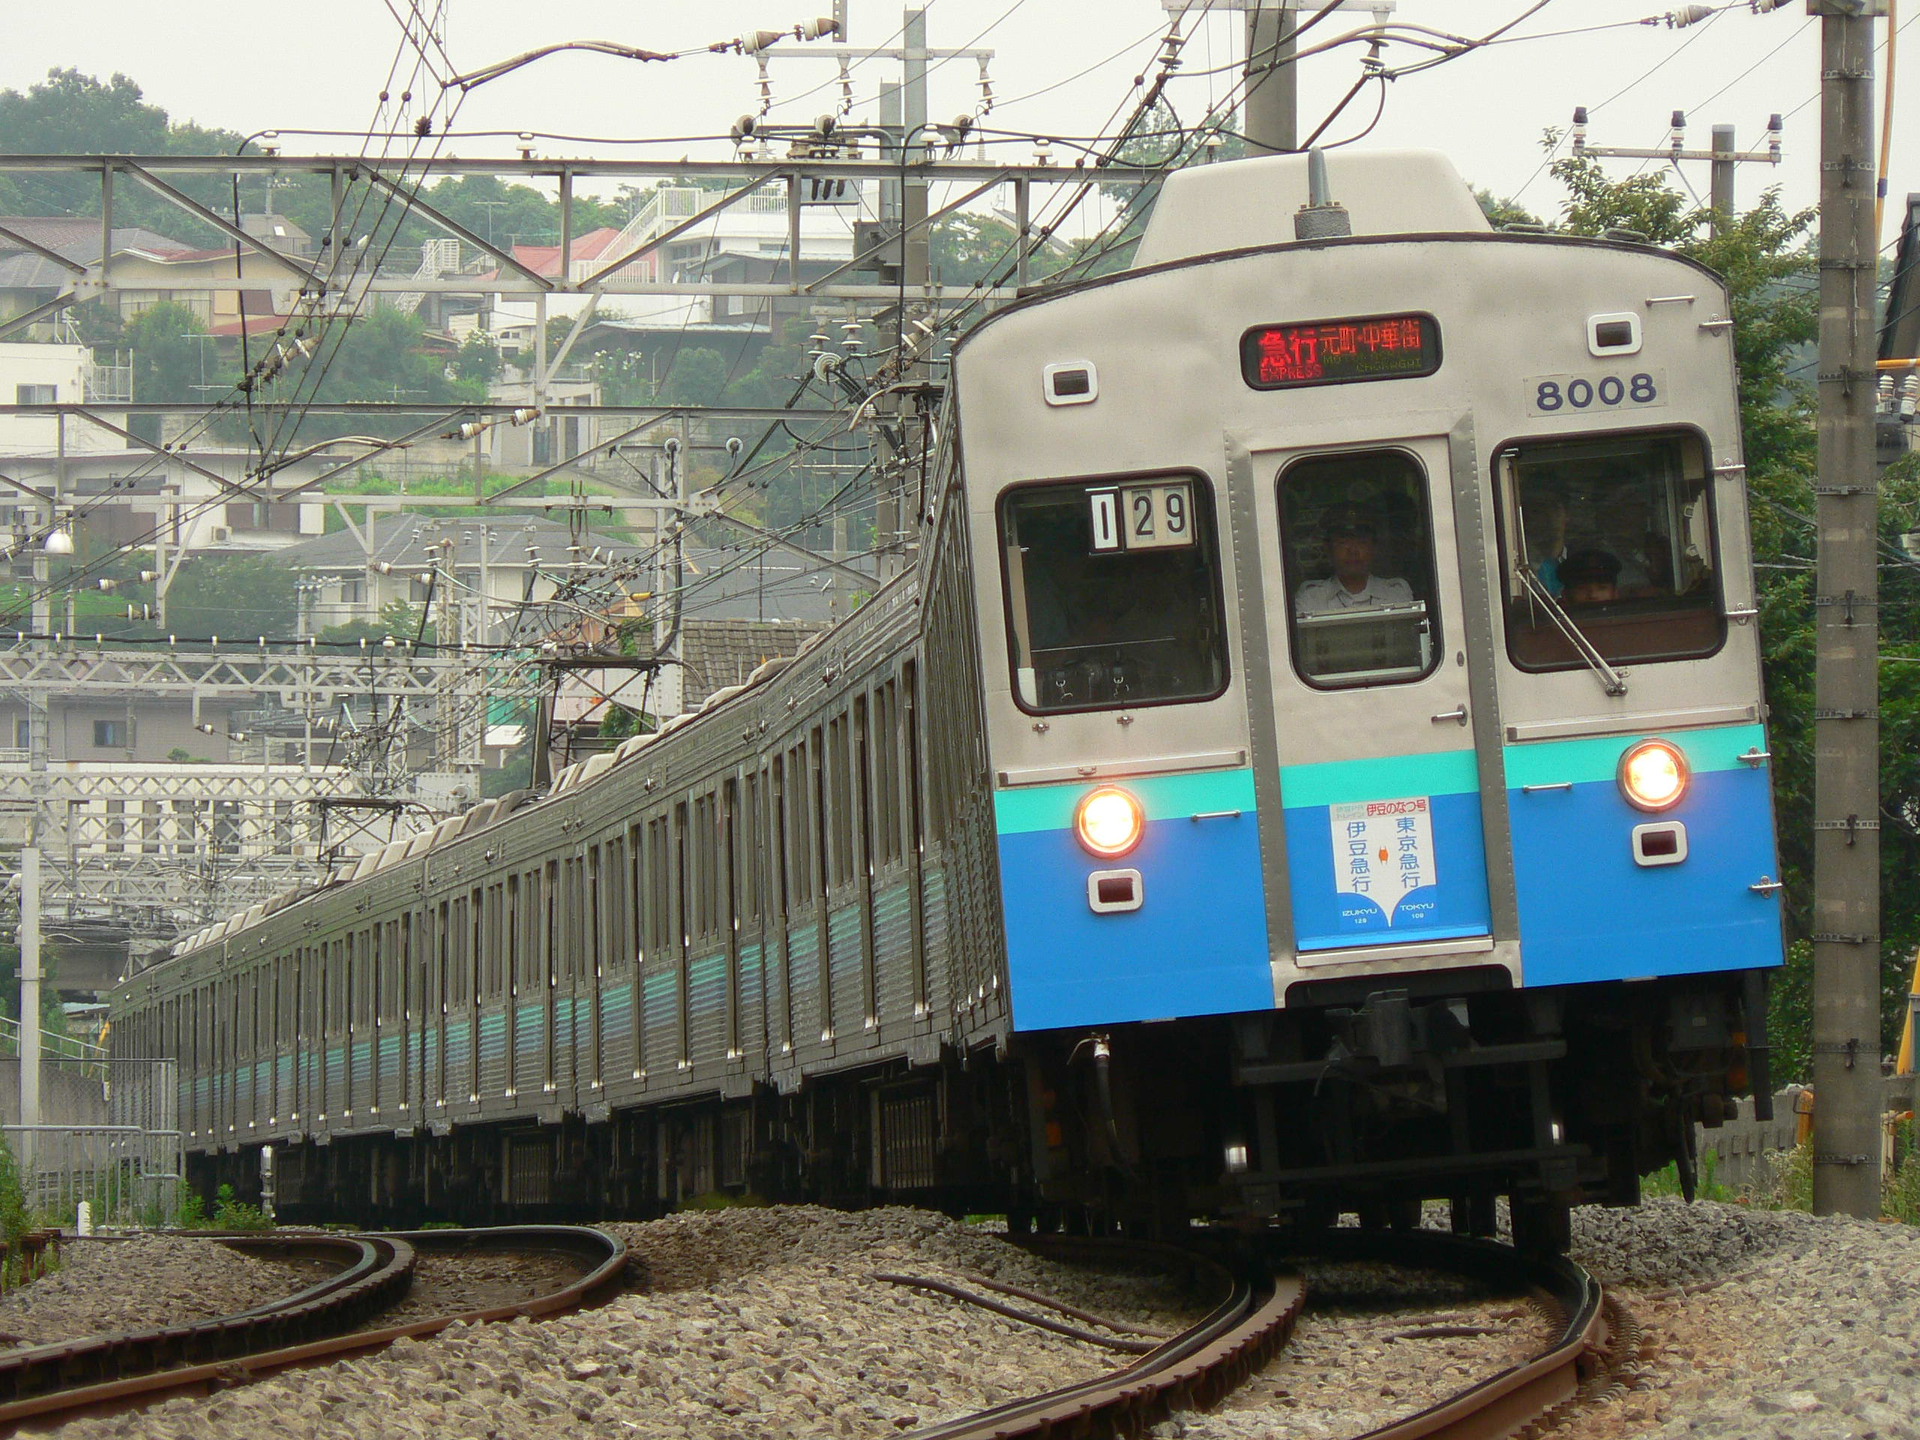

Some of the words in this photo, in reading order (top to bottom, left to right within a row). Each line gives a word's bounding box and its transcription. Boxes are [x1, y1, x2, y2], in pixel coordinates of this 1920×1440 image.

[1259, 329, 1318, 368] 急行
[1260, 364, 1323, 382] EXPRESS
[1537, 373, 1657, 411] 8008
[1367, 799, 1426, 816] 伊豆のなつ号
[1347, 821, 1372, 893] 伊豆急行
[1396, 817, 1421, 888] 東京急行
[1342, 907, 1377, 917] IZUKYU
[1400, 903, 1434, 911] TOKYU
